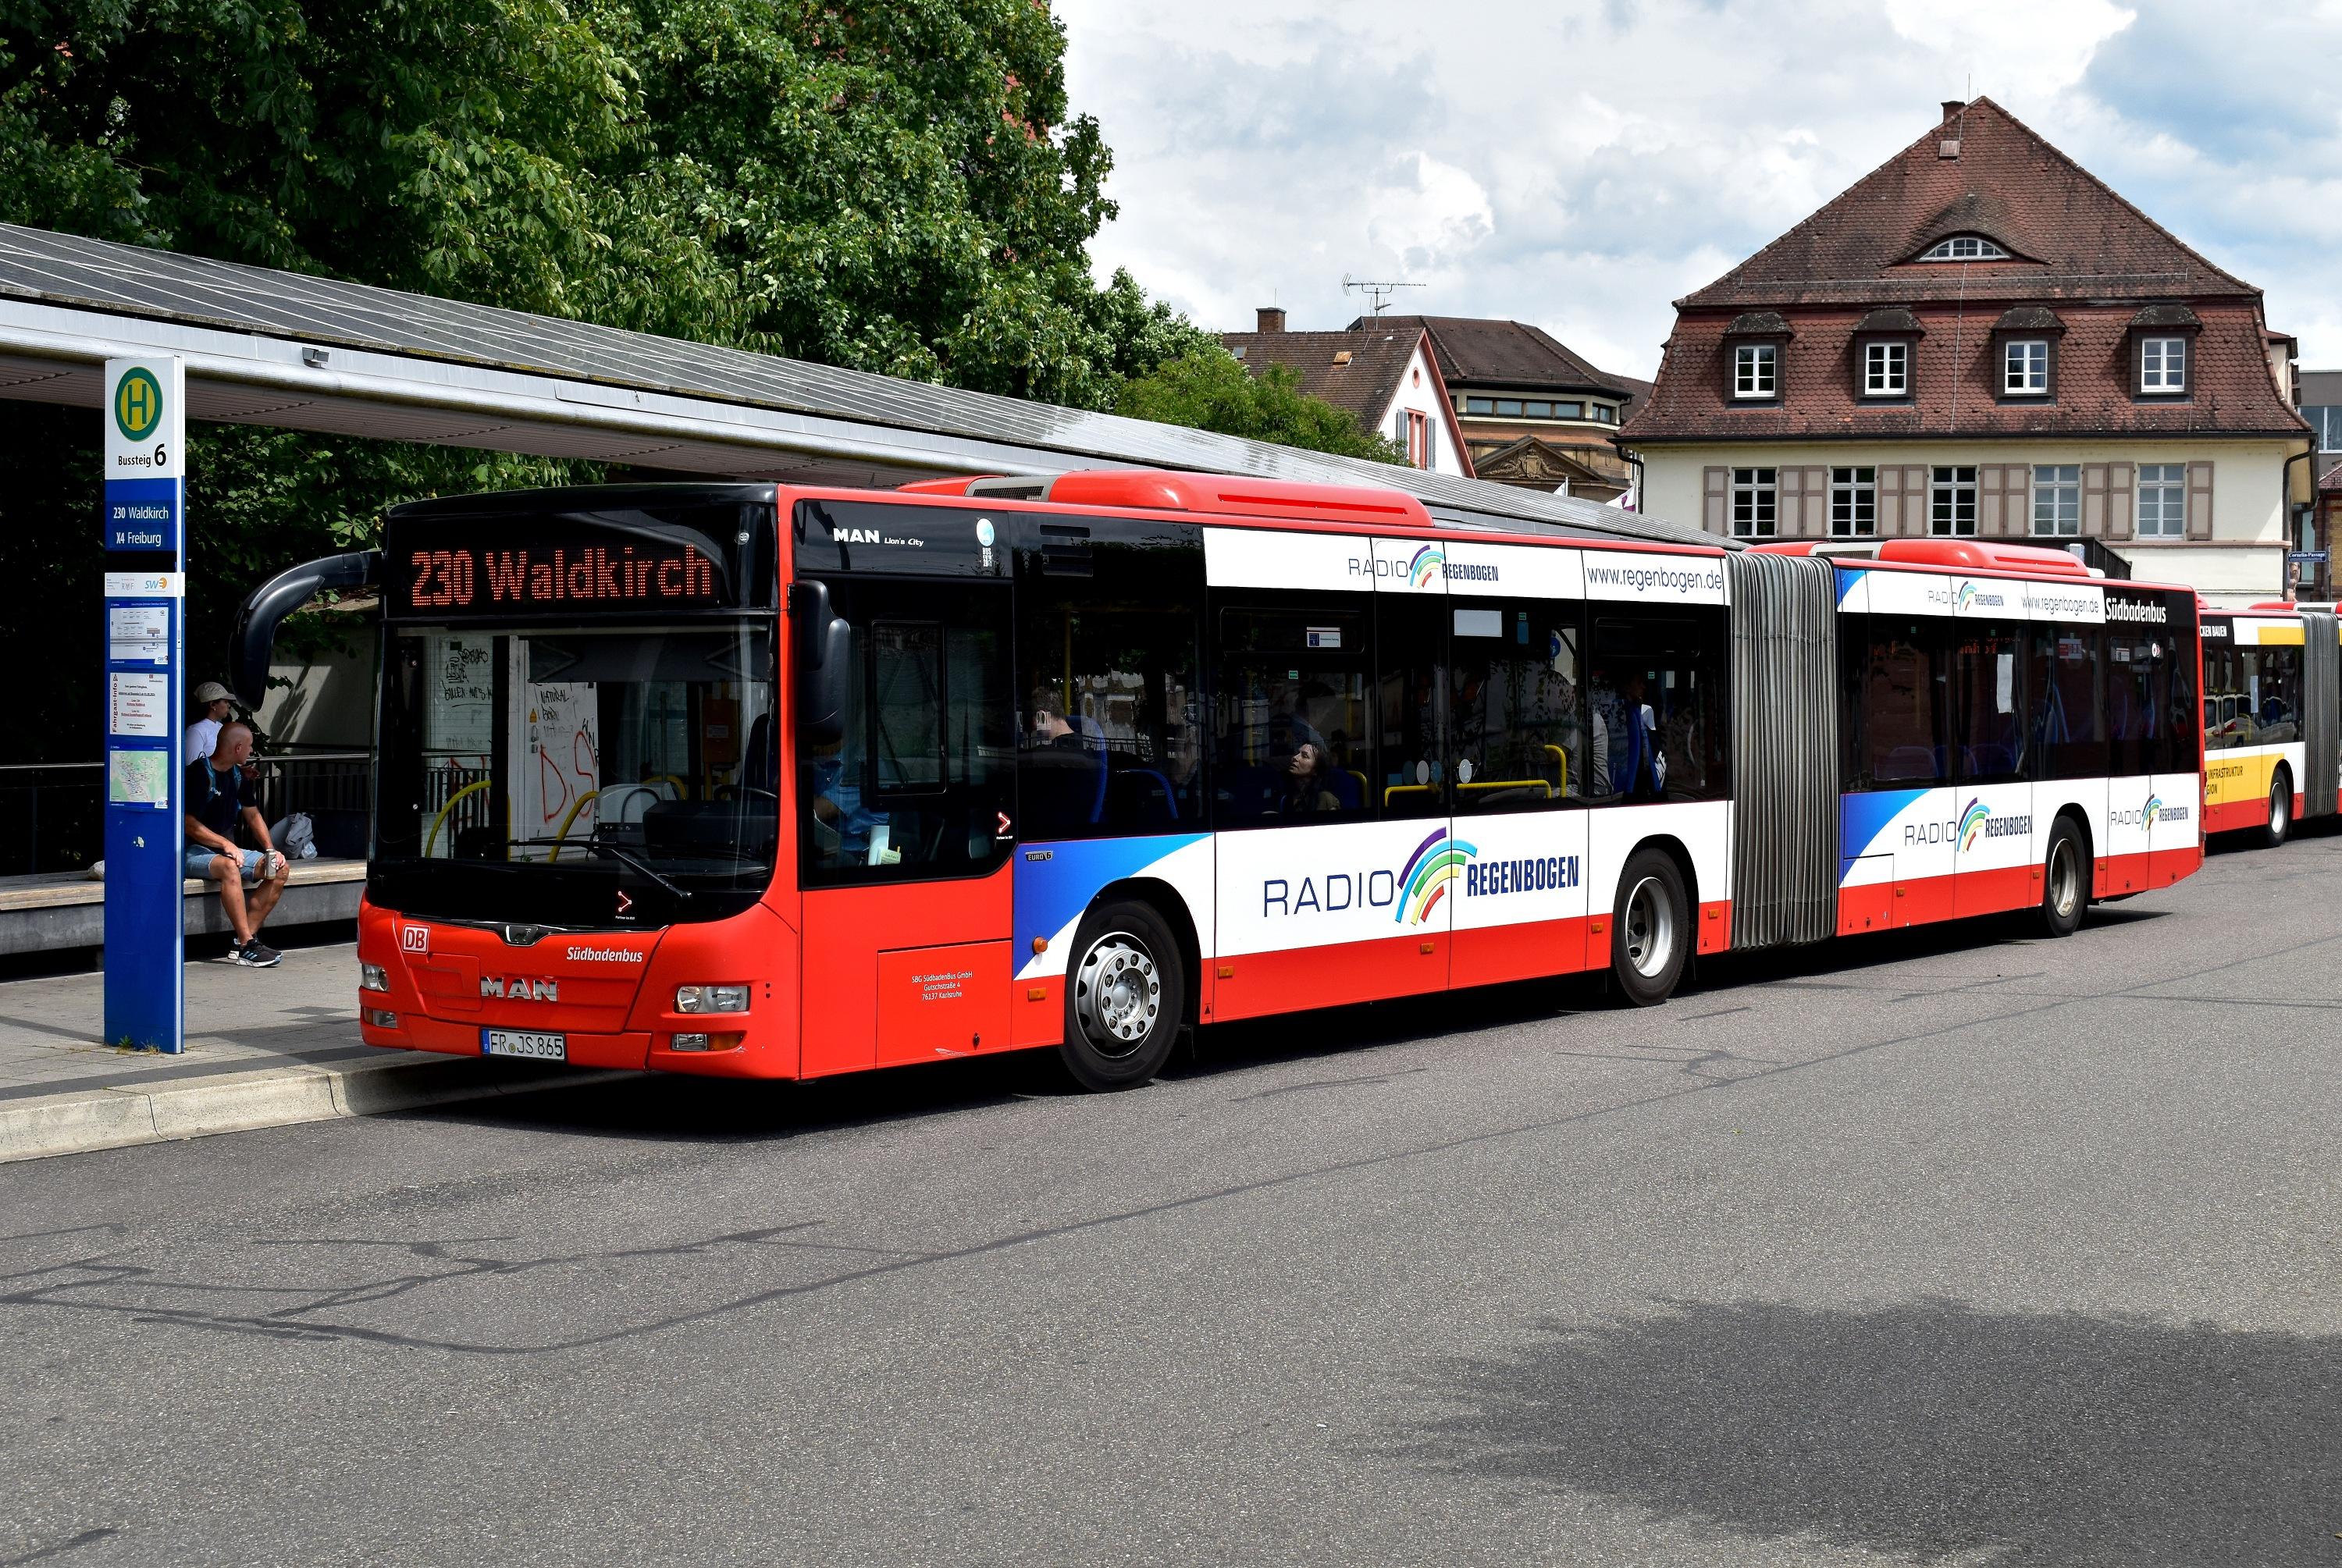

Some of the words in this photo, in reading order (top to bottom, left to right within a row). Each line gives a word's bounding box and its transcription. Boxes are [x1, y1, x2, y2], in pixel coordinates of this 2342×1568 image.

[118, 453, 151, 468] Bussteig
[154, 443, 167, 466] 6
[113, 507, 126, 519] 230
[128, 507, 169, 519] Waldkirch
[116, 532, 125, 544] X4
[127, 532, 162, 546] Freiburg
[833, 528, 880, 543] MAN
[907, 538, 924, 547] City
[411, 549, 474, 606] 230
[486, 544, 711, 601] Waldkirch
[1348, 557, 1408, 578] RADIO
[1442, 562, 1499, 582] REGENBOGEN
[1587, 566, 1723, 593] www.regenbogen.de
[1927, 589, 1958, 605] RADIO
[1974, 593, 2004, 607] REGENBOGEN
[2021, 593, 2099, 617] www.regenbogen.de
[2105, 596, 2166, 624] Südbadenbus
[2212, 625, 2227, 637] BAUEN
[2208, 766, 2244, 780] INFRASTRUKTUR
[2110, 809, 2142, 827] RADIO
[2159, 805, 2189, 823] REGENBOGEN
[1905, 820, 1957, 848] RADIO
[1984, 813, 2033, 839] REGENBOGEN
[1264, 869, 1395, 918] RADIO
[1467, 855, 1579, 898] REGENBOGEN
[404, 928, 426, 951] DB
[566, 946, 643, 963] Südbadenbus
[480, 976, 558, 1002] MAN
[922, 992, 938, 1001] 76137
[938, 990, 963, 999] Karlsruhe
[924, 982, 956, 991] Gutschstraße
[490, 1033, 507, 1052] FR
[517, 1035, 534, 1054] JS
[537, 1036, 563, 1058] 865
